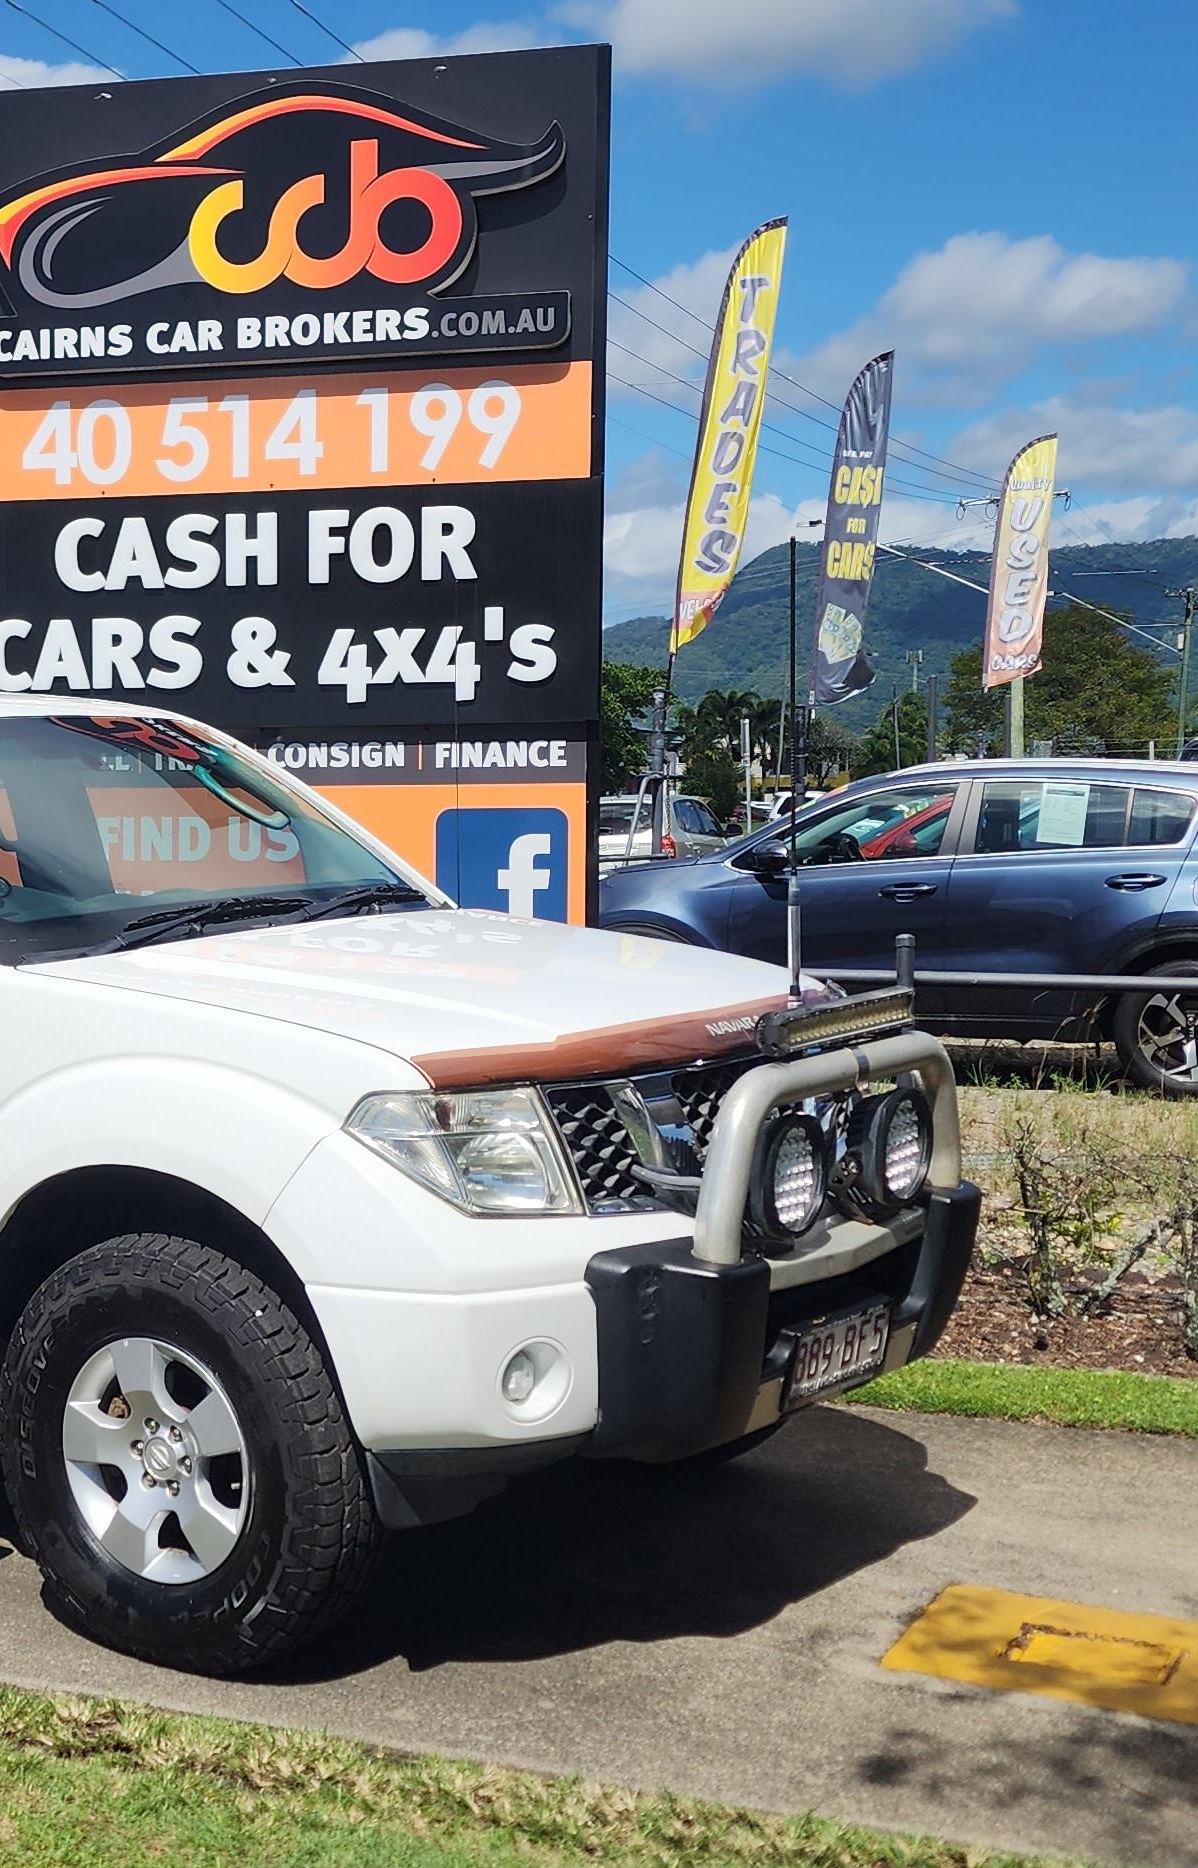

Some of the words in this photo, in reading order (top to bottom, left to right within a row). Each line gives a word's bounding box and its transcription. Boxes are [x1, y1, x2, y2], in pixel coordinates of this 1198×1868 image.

[146, 320, 224, 354] CAR
[22, 398, 132, 486] 40
[155, 388, 324, 483] 514
[355, 379, 522, 472] 199
[695, 274, 771, 576] TRADES
[54, 512, 278, 592] CASH
[308, 505, 479, 585] FOR
[846, 517, 867, 534] FOR
[997, 495, 1044, 643] USED
[226, 616, 296, 688] &
[267, 742, 405, 769] CONSIGN
[435, 740, 568, 768] FINANCE
[98, 816, 212, 862] FIND
[228, 816, 301, 863] US
